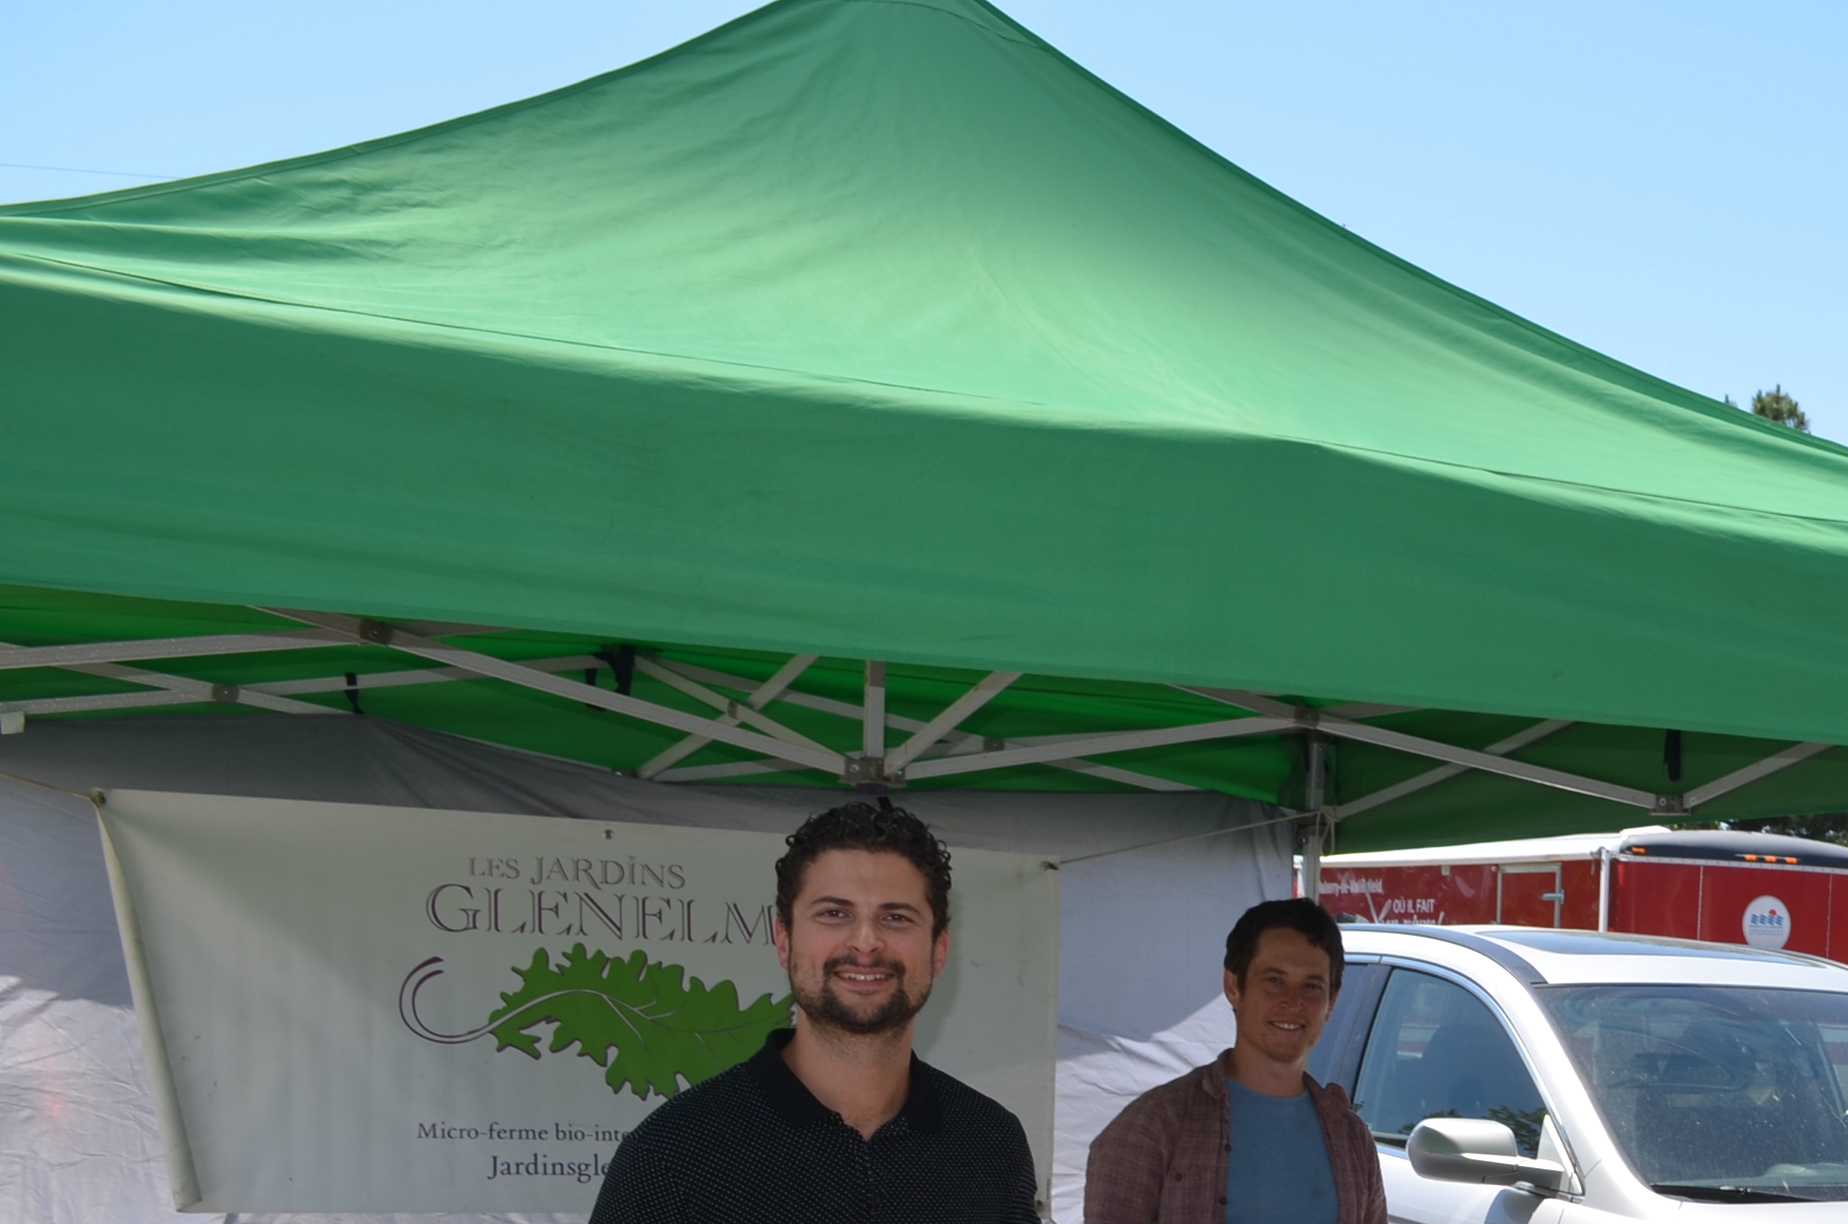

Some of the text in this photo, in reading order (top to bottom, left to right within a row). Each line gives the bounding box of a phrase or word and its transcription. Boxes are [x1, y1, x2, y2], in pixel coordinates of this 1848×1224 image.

[468, 855, 687, 890] LES JARDINS
[425, 883, 778, 946] GLENELM
[1416, 899, 1436, 913] FAIT
[417, 1121, 634, 1142] Micro-ferme bio-inte
[487, 1152, 610, 1184] Jardinsgle
